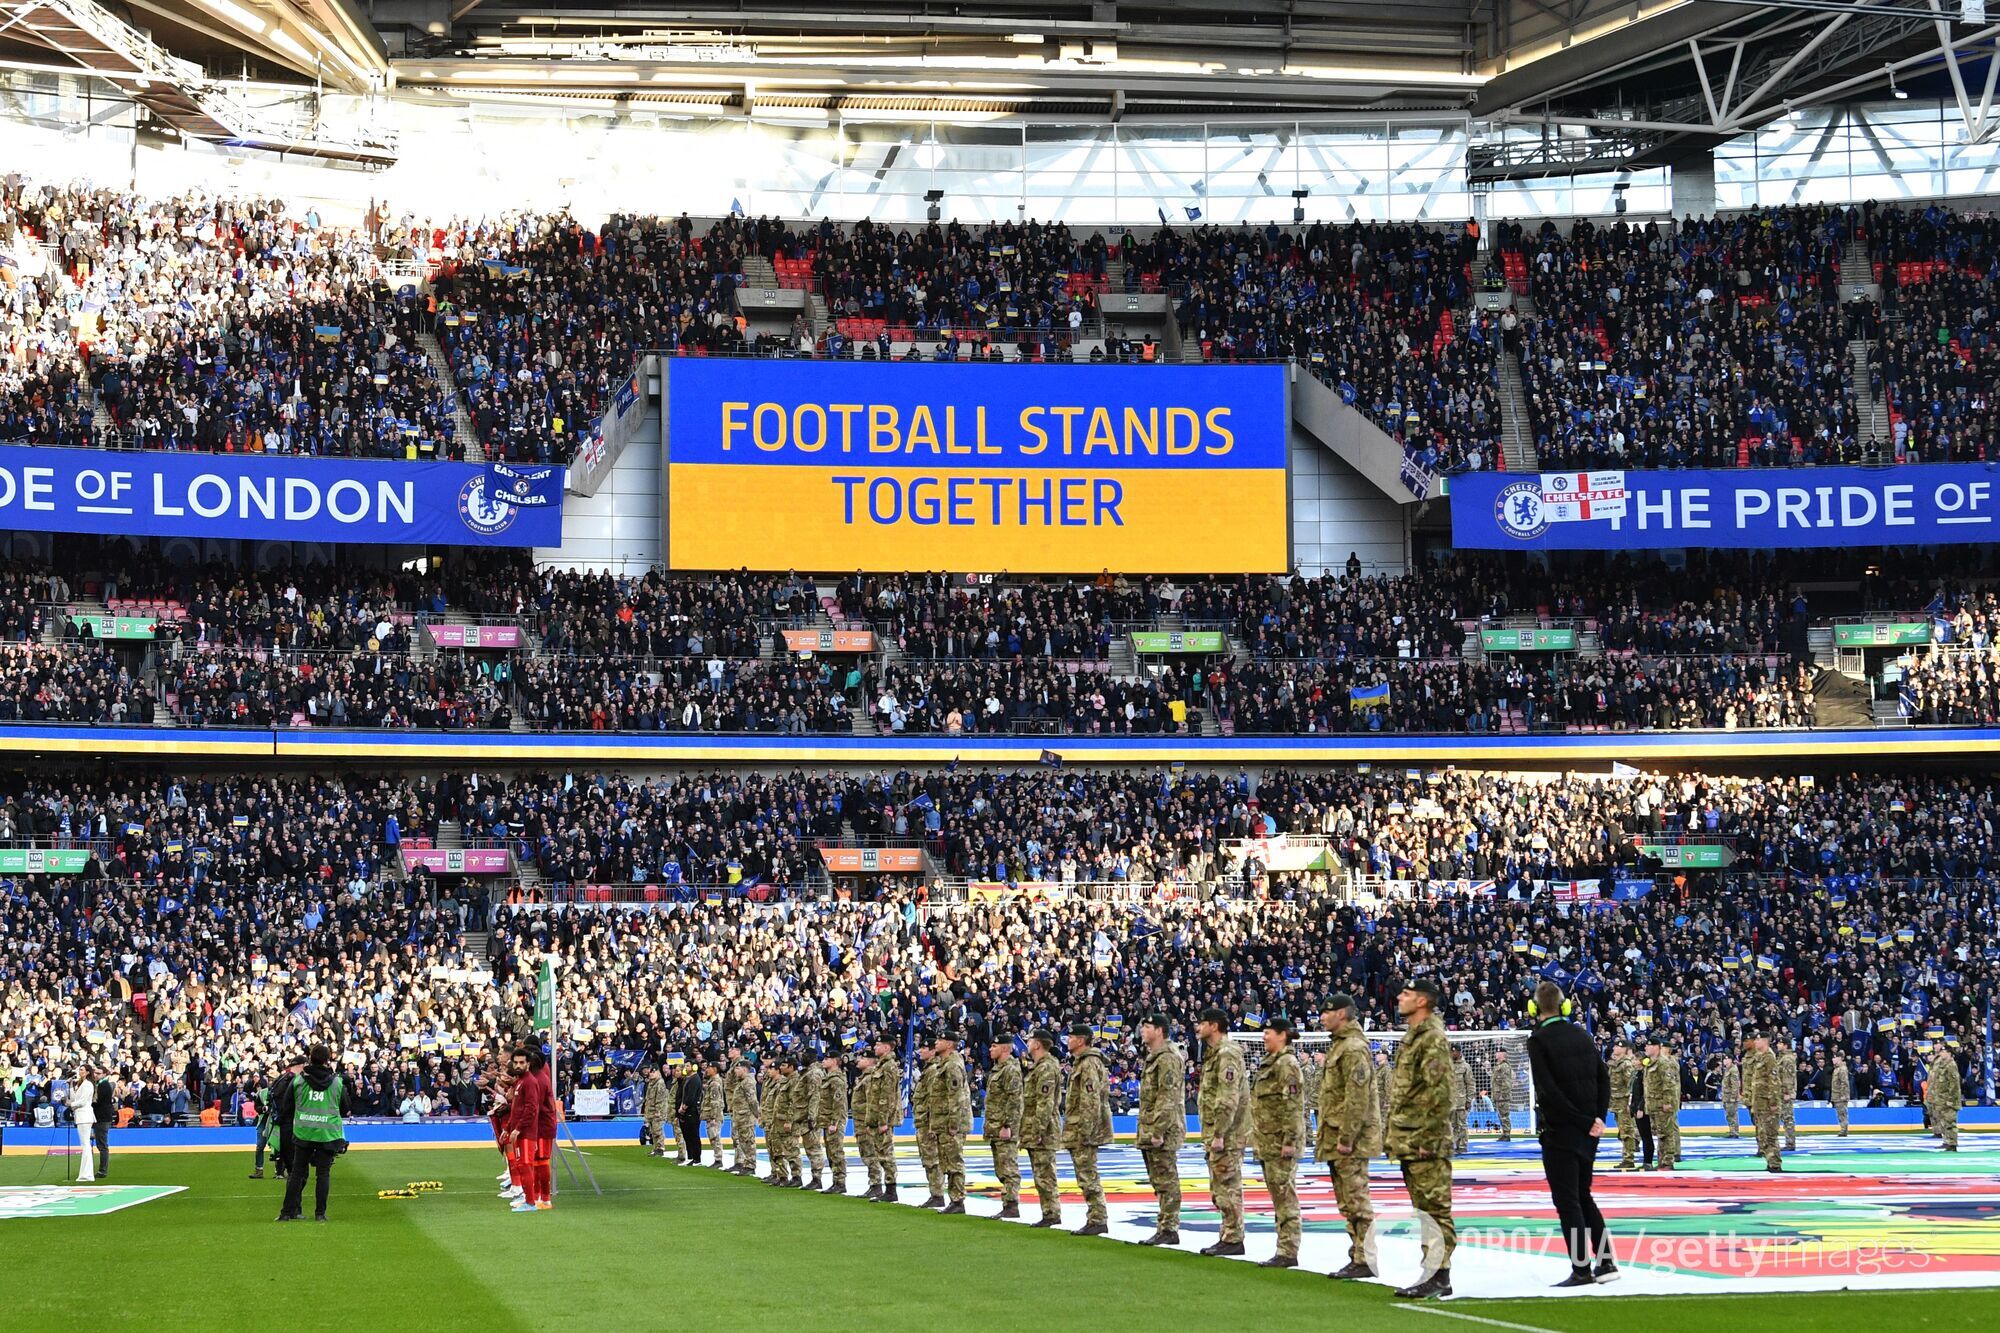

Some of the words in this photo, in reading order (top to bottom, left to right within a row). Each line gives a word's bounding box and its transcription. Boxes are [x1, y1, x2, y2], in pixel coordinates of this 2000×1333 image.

[721, 401, 1003, 455] FOOTBALL
[1018, 405, 1234, 456] STANDS
[75, 469, 133, 500] OF
[153, 472, 414, 524] LONDON
[495, 489, 547, 505] CHELSEA
[831, 476, 1125, 527] TOGETHER
[1545, 492, 1604, 502] CHELSEA
[1606, 490, 1624, 499] FC
[1735, 484, 1916, 529] PRIDE
[1934, 481, 1991, 512] OF
[468, 520, 492, 532] FOOTBALL
[494, 520, 508, 531] CLUB
[1505, 526, 1530, 537] FOOTBALL
[1532, 524, 1545, 536] CLUB
[979, 574, 993, 584] LG
[308, 1090, 325, 1102] 134
[300, 1114, 328, 1122] BROADCAST
